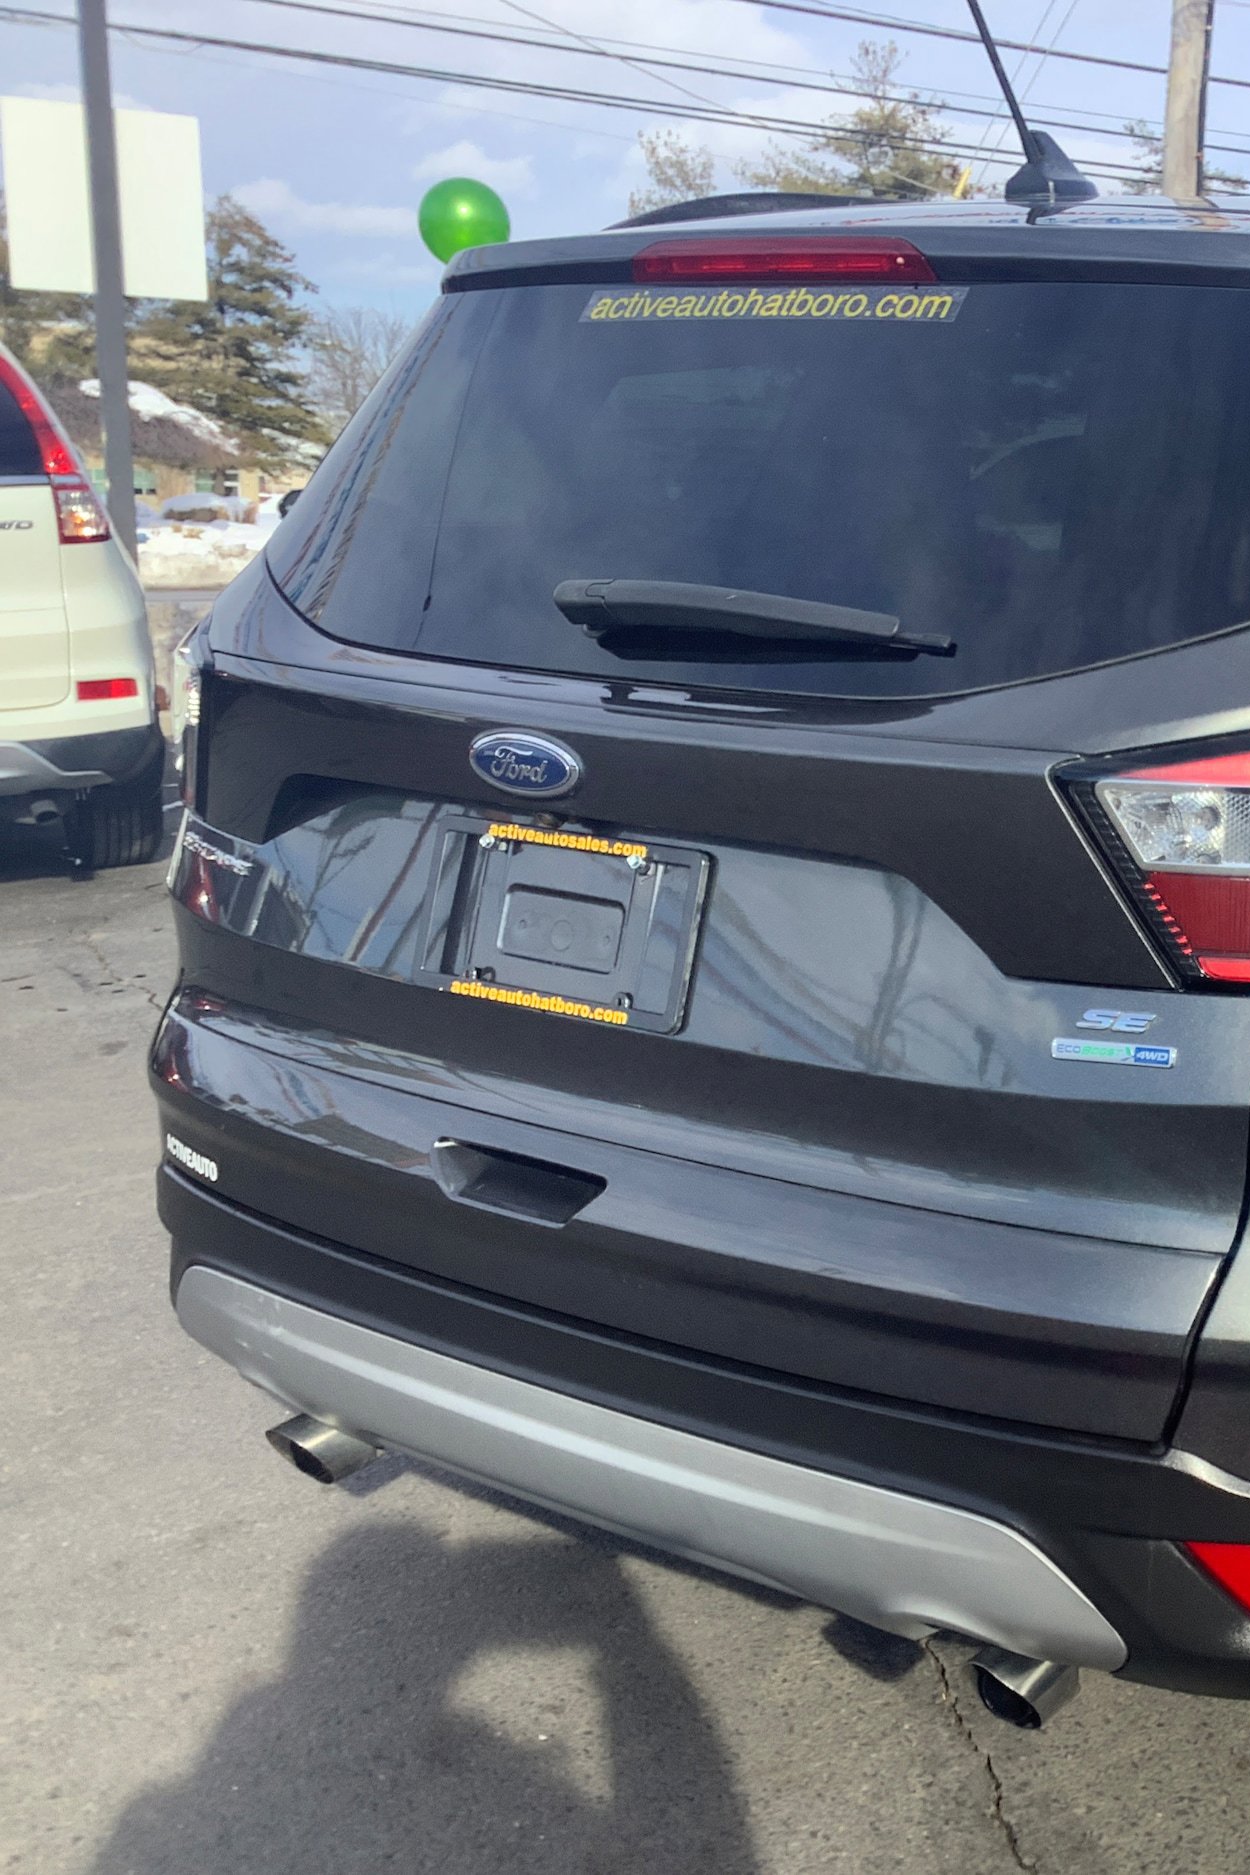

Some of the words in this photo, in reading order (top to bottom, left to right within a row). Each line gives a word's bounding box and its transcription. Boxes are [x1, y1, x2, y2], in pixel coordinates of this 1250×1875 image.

[589, 287, 954, 321] activeautohatboro.com
[490, 745, 549, 783] Ford
[487, 822, 647, 859] activeautosales.com
[450, 979, 628, 1025] activeautohatboro.com
[1076, 1009, 1157, 1033] SE
[1136, 1051, 1169, 1062] 4WD
